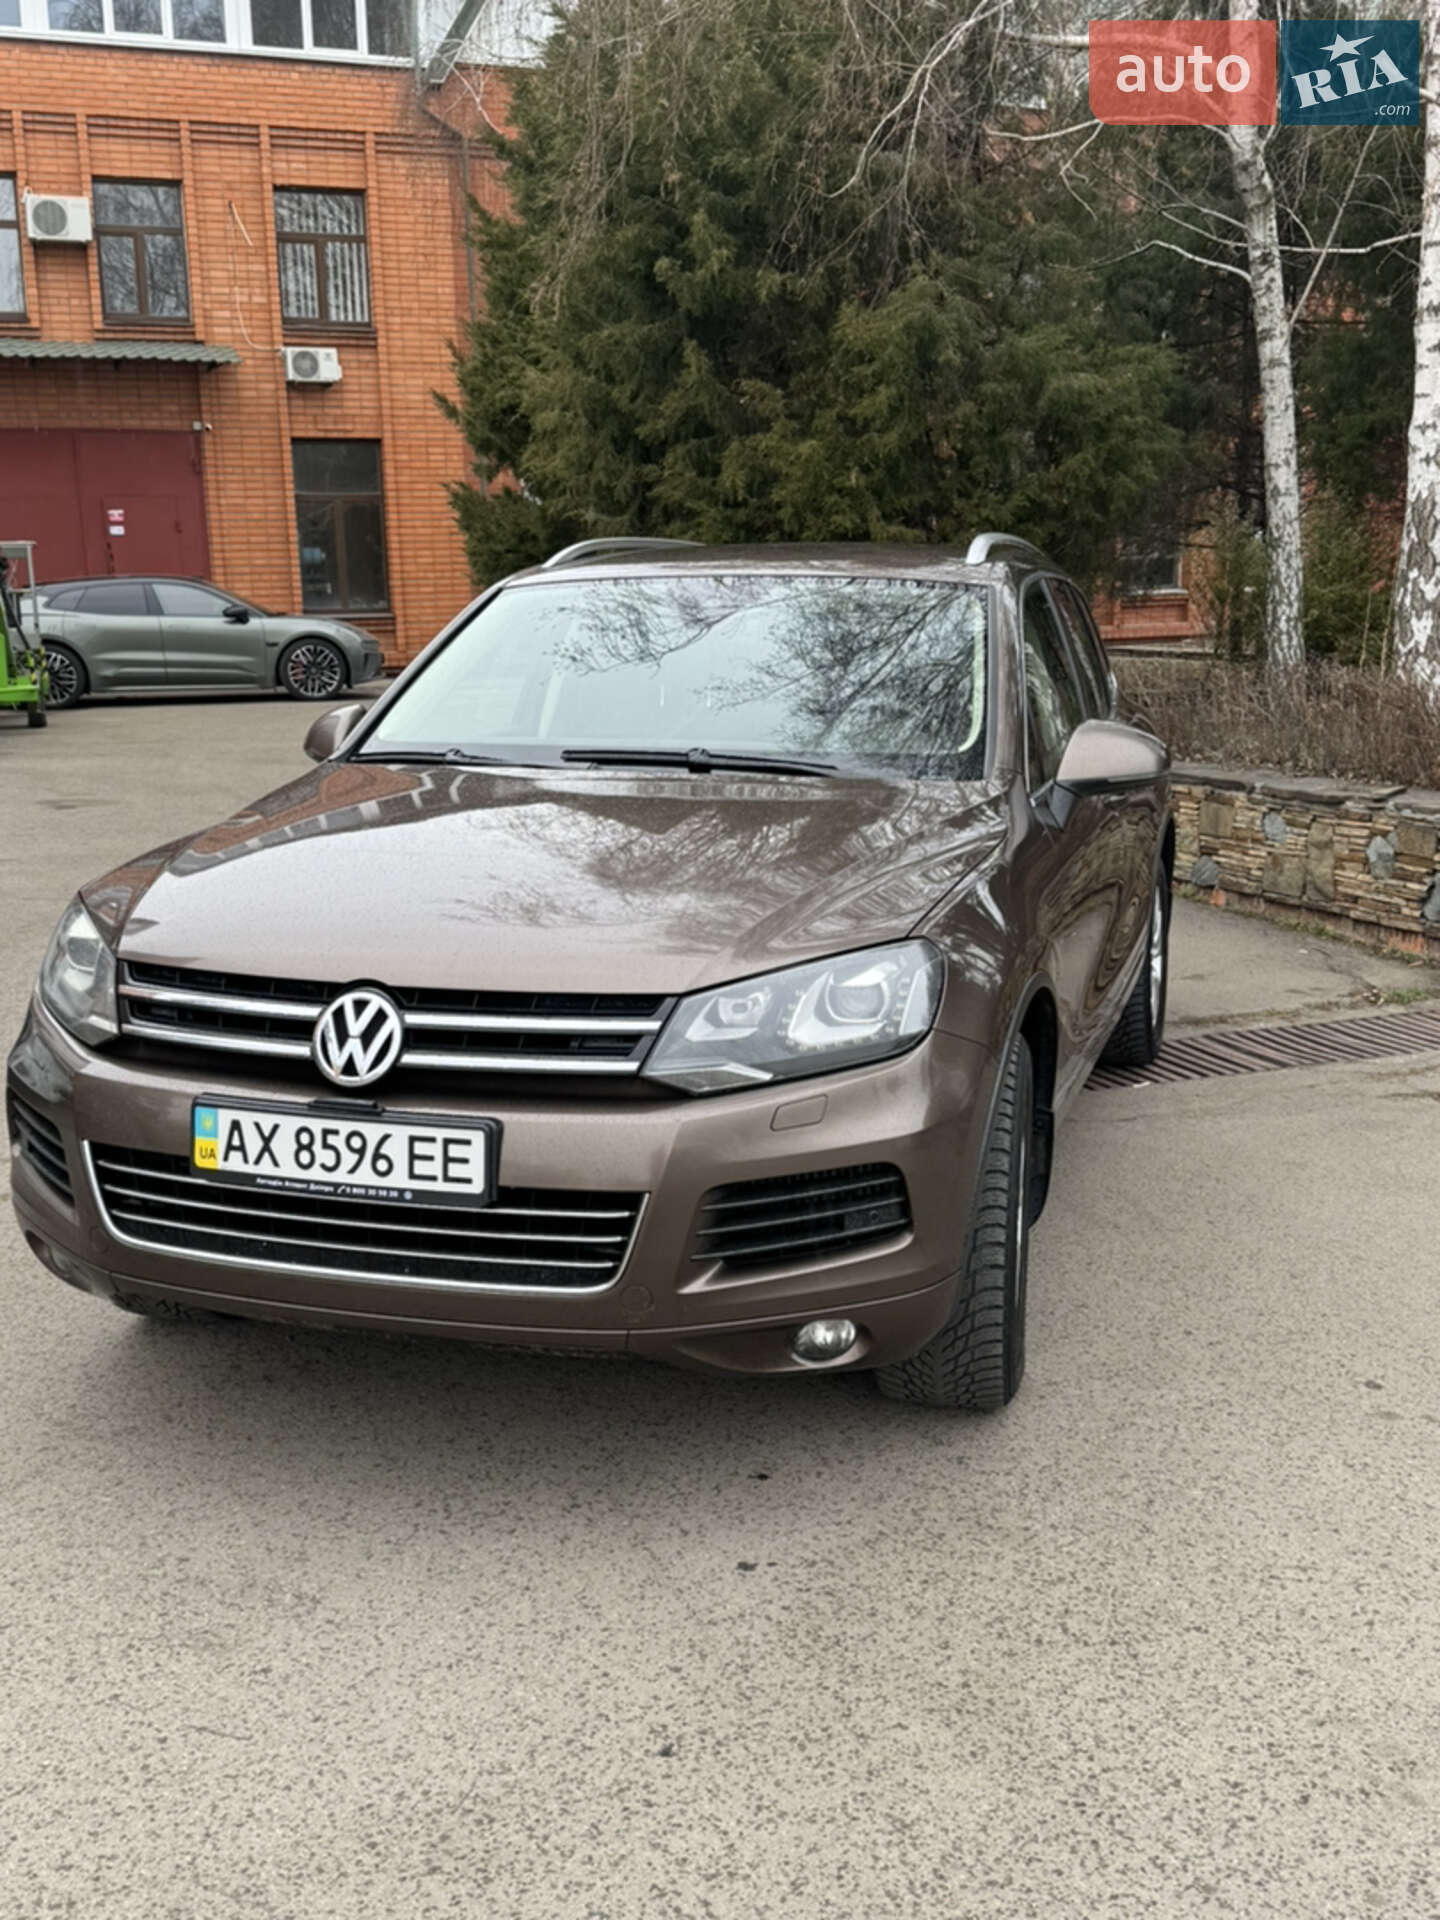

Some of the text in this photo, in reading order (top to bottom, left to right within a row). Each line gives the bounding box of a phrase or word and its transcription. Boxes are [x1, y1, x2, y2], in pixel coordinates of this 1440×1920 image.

[200, 1146, 217, 1160] UA
[223, 1119, 473, 1184] AX 8596 EE
